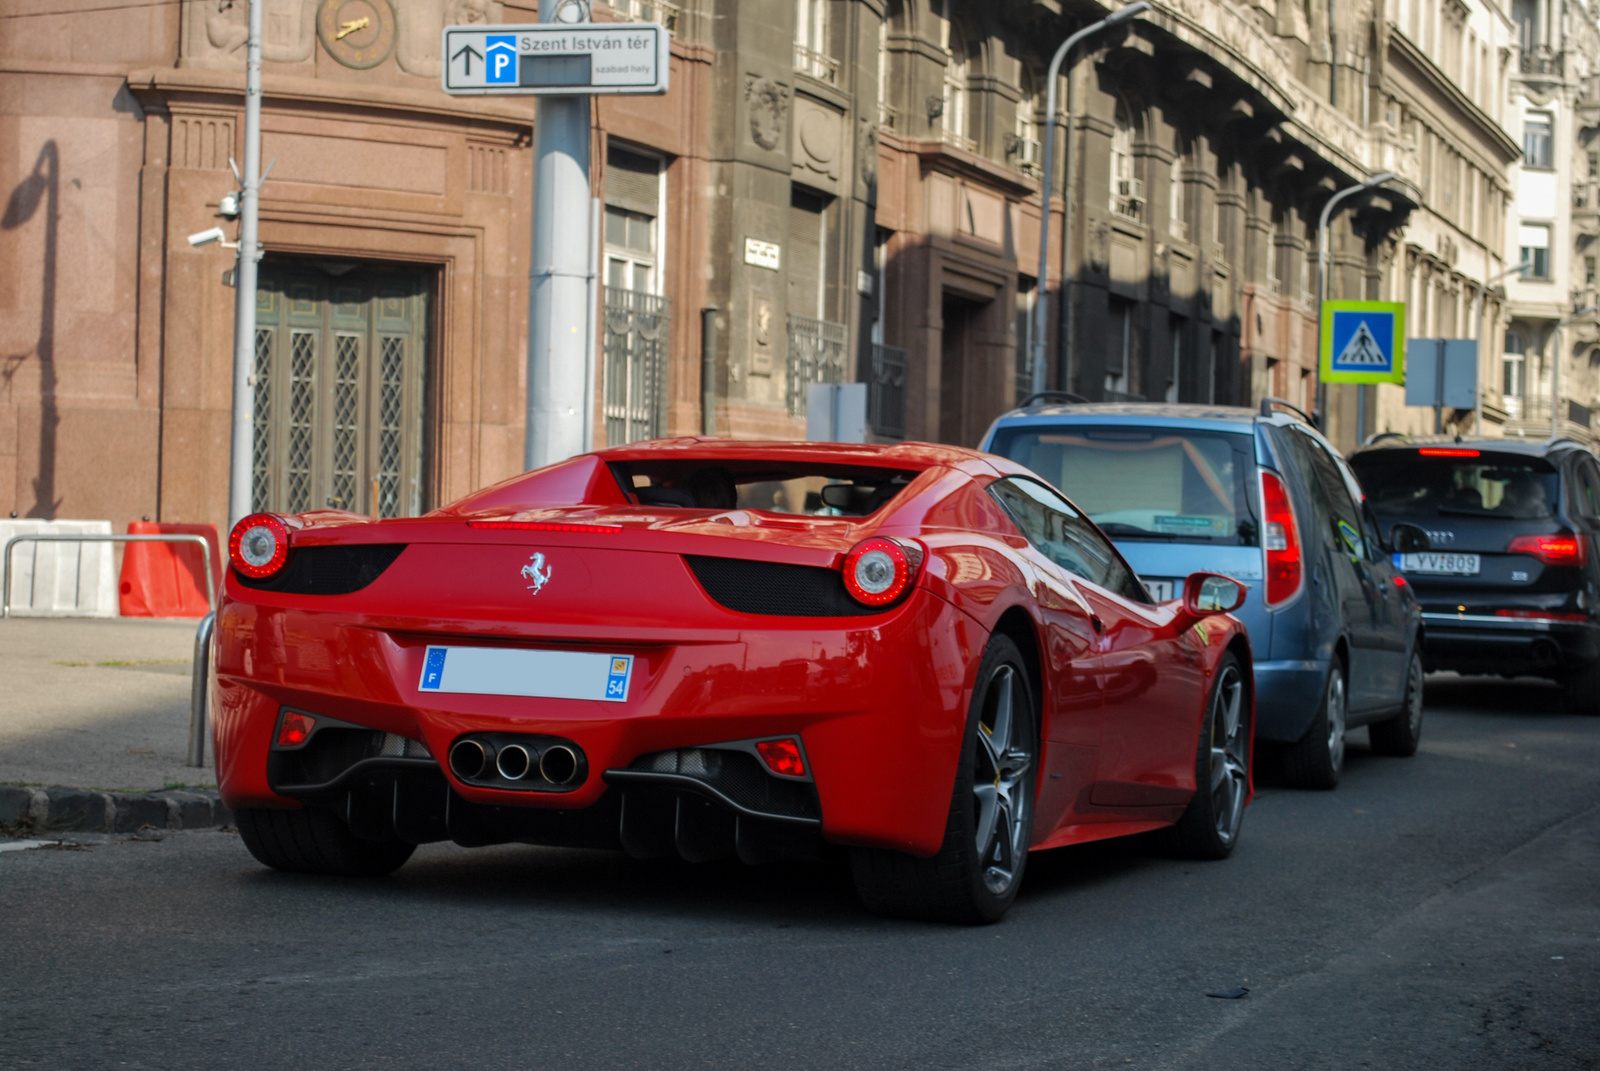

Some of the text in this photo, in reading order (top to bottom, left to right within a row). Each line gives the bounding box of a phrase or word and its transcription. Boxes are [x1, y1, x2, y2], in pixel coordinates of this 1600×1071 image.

[521, 36, 650, 51] Szent István tér
[495, 54, 510, 79] P
[595, 66, 650, 75] szabad hely
[428, 673, 437, 683] F
[608, 680, 623, 695] 54
